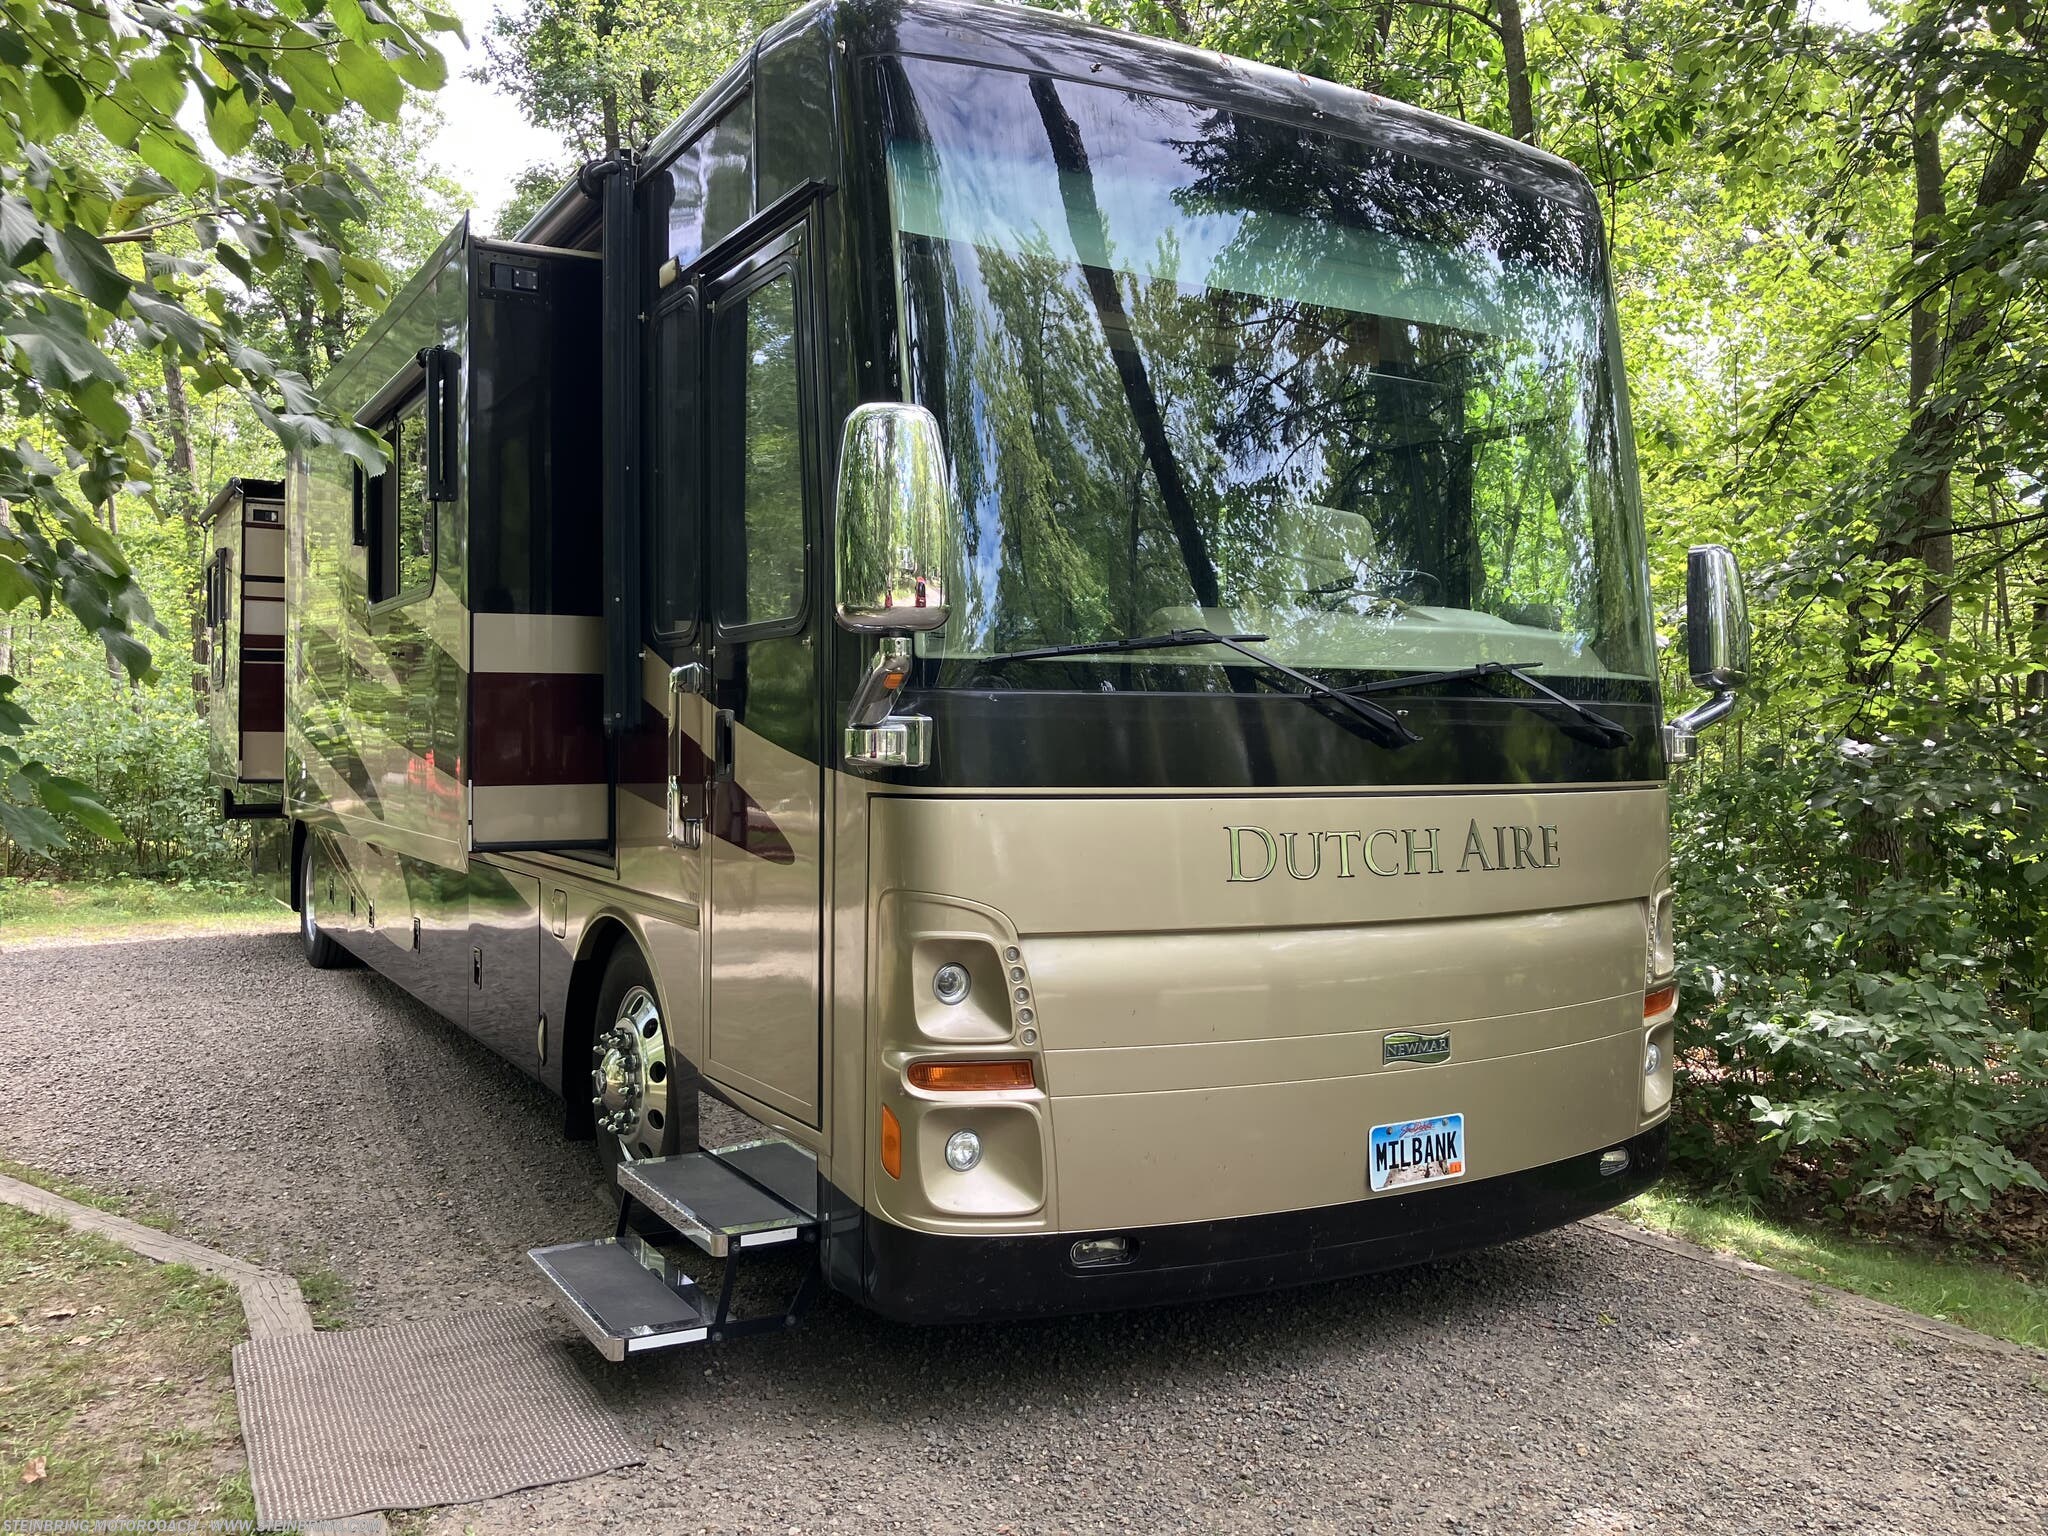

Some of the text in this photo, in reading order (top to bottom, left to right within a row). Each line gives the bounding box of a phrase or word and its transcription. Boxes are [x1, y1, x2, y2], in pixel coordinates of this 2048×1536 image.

[1223, 818, 1561, 882] DUTCH AIRE
[1386, 1039, 1449, 1057] NEWMAR
[1376, 1131, 1457, 1172] MILBANK
